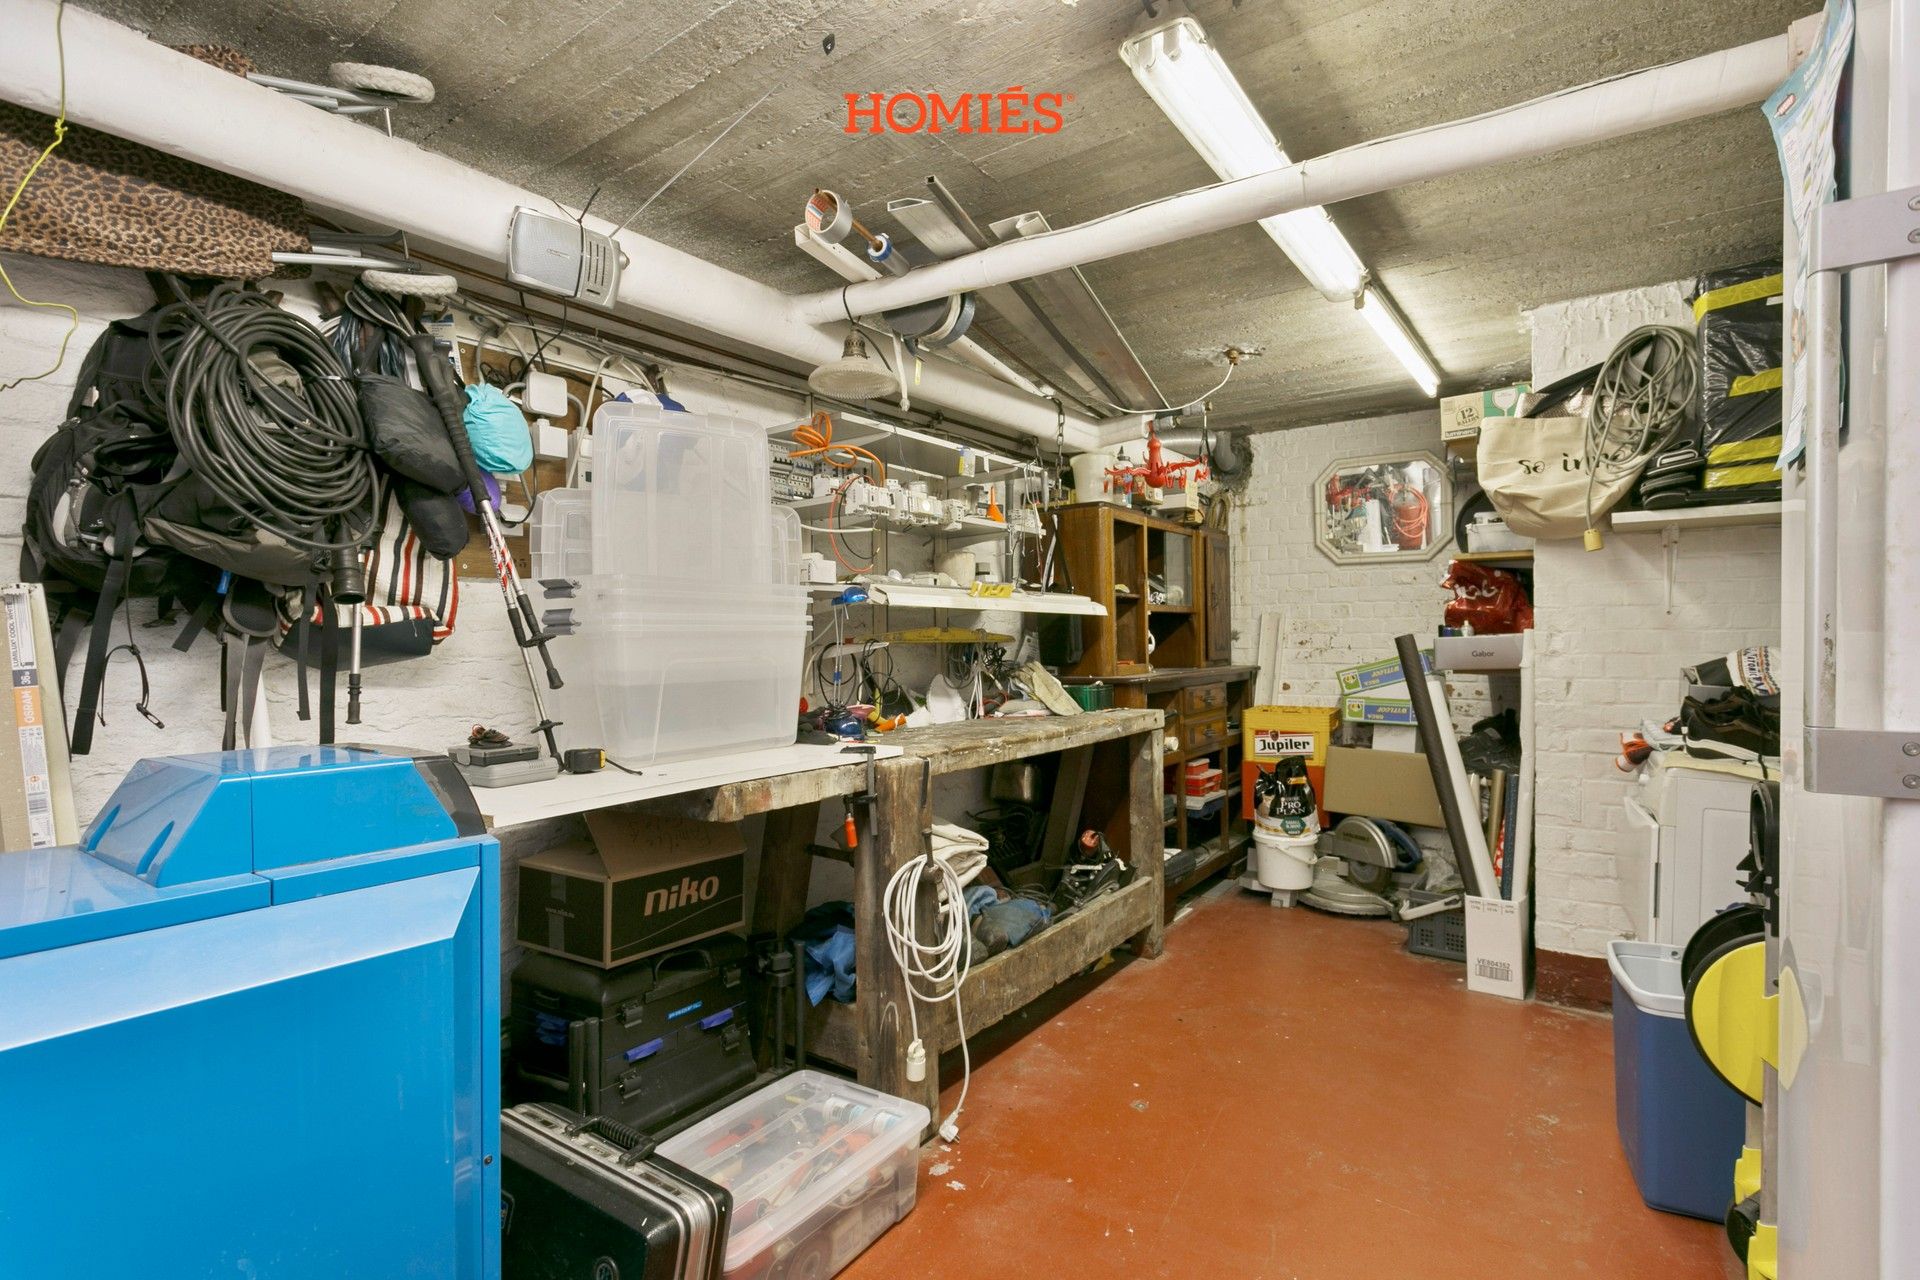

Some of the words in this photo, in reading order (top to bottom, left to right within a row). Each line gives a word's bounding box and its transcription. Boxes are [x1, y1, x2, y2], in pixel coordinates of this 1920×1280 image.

[1460, 407, 1474, 420] 12
[1518, 459, 1546, 475] so
[1471, 649, 1495, 658] Gabor
[21, 690, 35, 723] OSRAM
[1259, 738, 1310, 753] Jupiler
[1276, 807, 1305, 815] PLAN
[1281, 800, 1302, 809] PRO
[644, 876, 719, 917] niko
